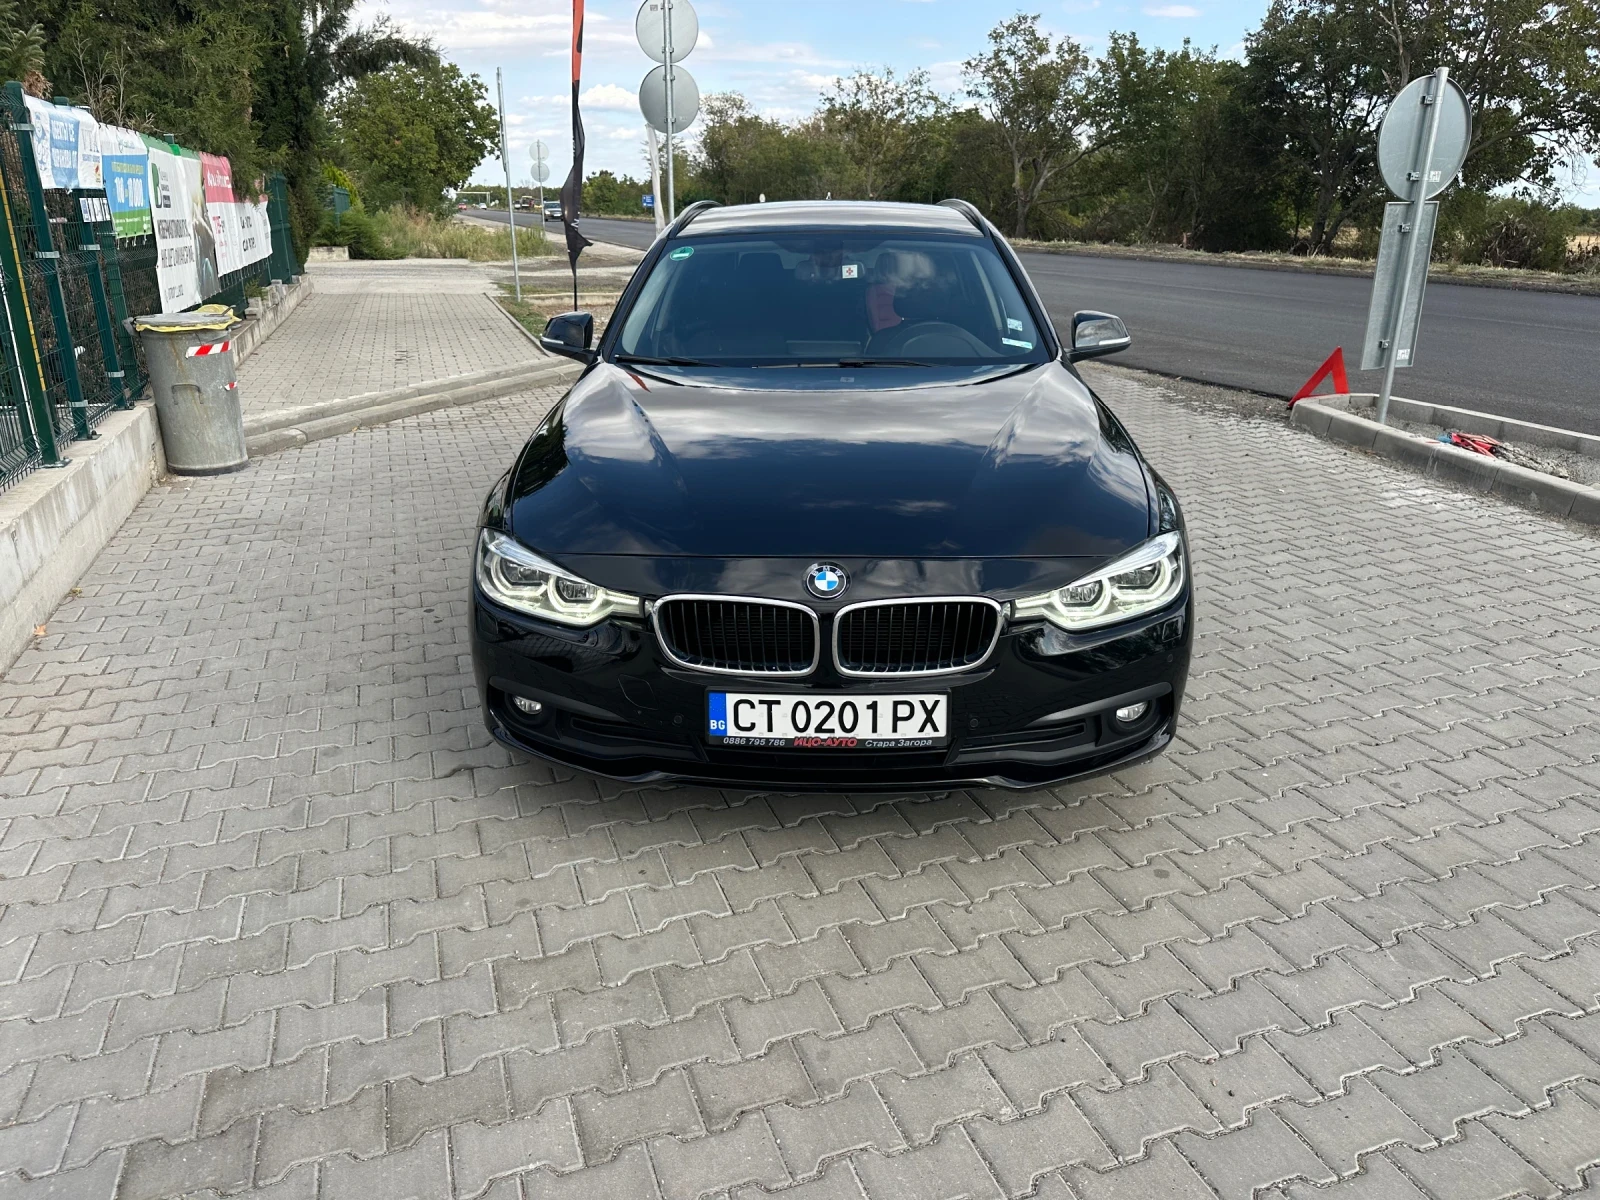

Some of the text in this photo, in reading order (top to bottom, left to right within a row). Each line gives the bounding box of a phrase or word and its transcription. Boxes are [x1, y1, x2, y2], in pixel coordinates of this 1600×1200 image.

[811, 566, 843, 577] BMW
[710, 720, 726, 730] BG
[723, 736, 786, 746] 0886 795 786
[793, 737, 858, 748] ИЦО-АУТО
[865, 738, 933, 748] Стара Загора
